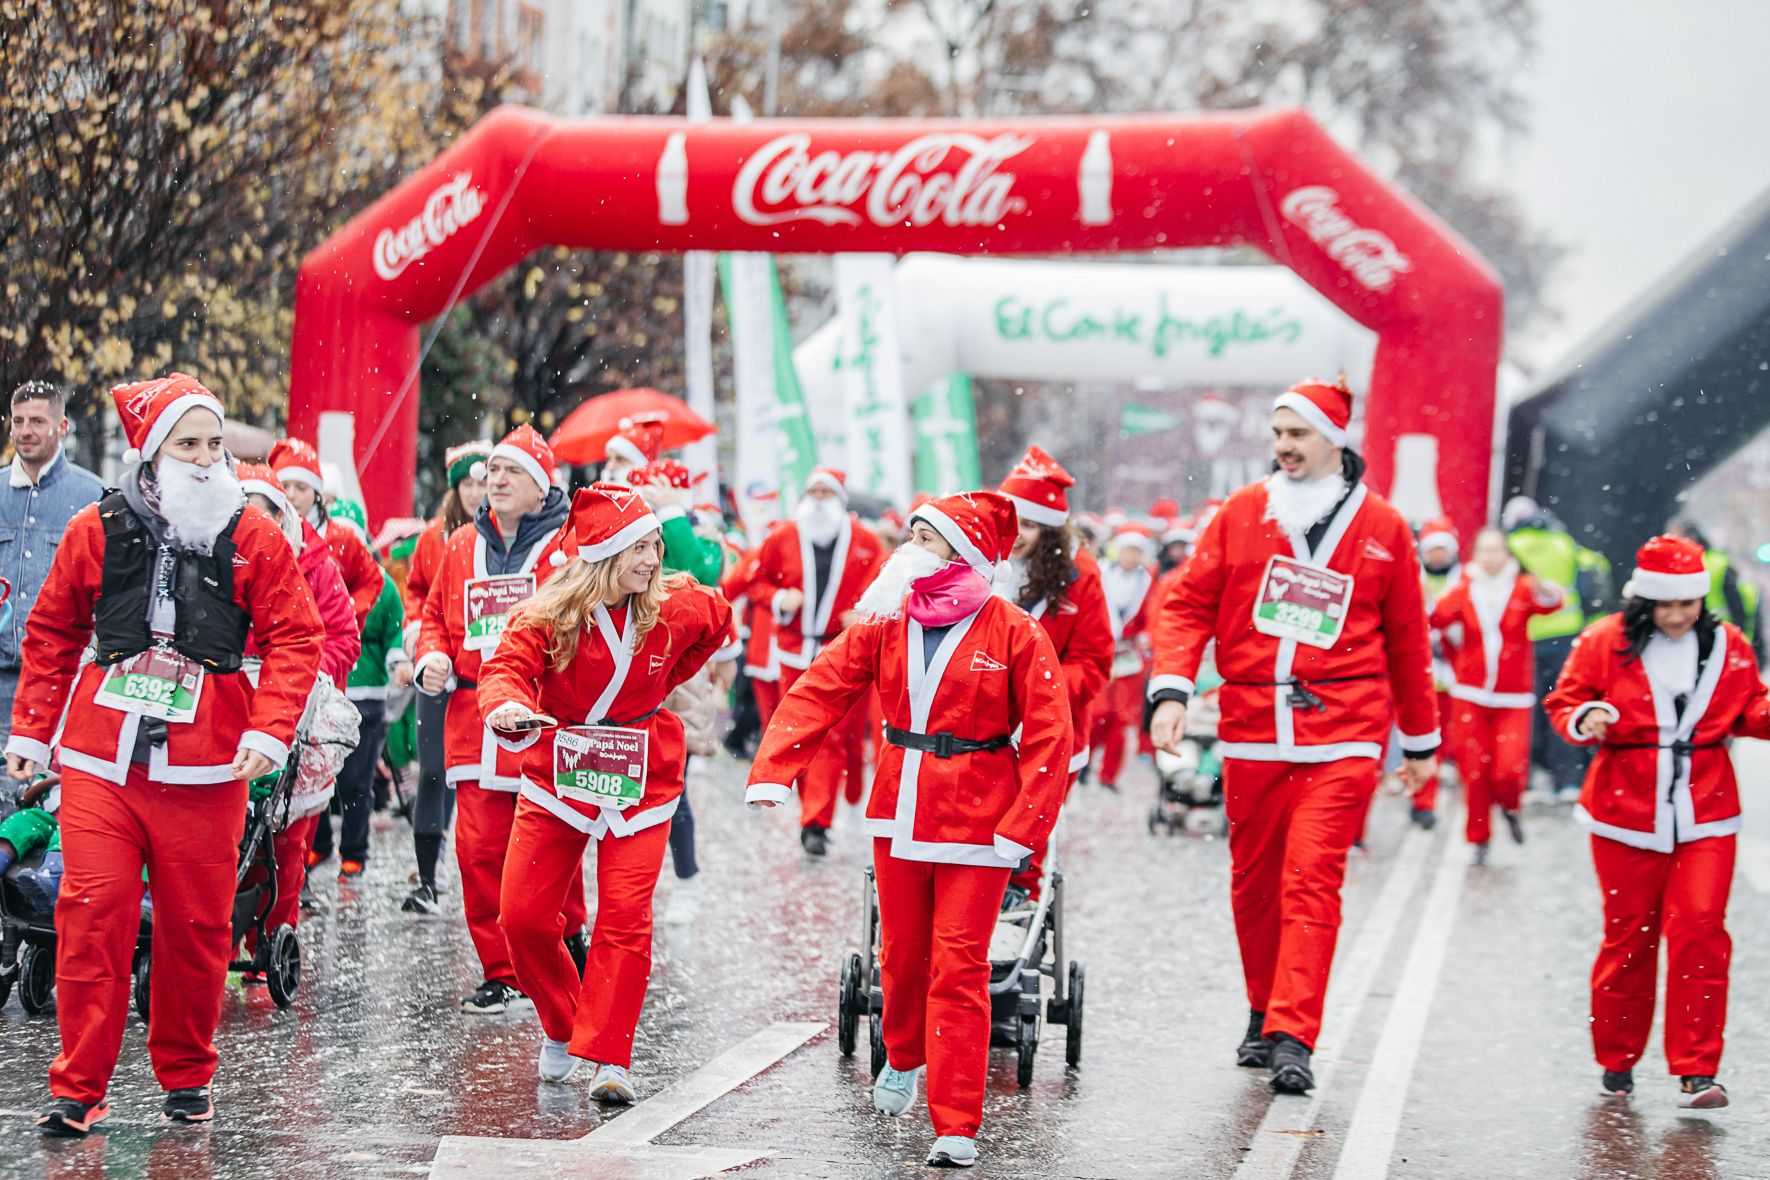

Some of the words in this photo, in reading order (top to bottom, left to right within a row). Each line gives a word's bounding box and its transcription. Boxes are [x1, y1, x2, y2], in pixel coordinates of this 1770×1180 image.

[731, 132, 1038, 227] Coca-Cola
[373, 170, 488, 281] Coca-Cola
[1281, 186, 1412, 291] Coca-Cola
[995, 296, 1032, 341] El
[1041, 298, 1142, 342] Corte
[123, 674, 178, 705] 6392
[590, 739, 615, 752] Papá
[616, 741, 639, 752] Noel
[575, 771, 622, 795] 5908
